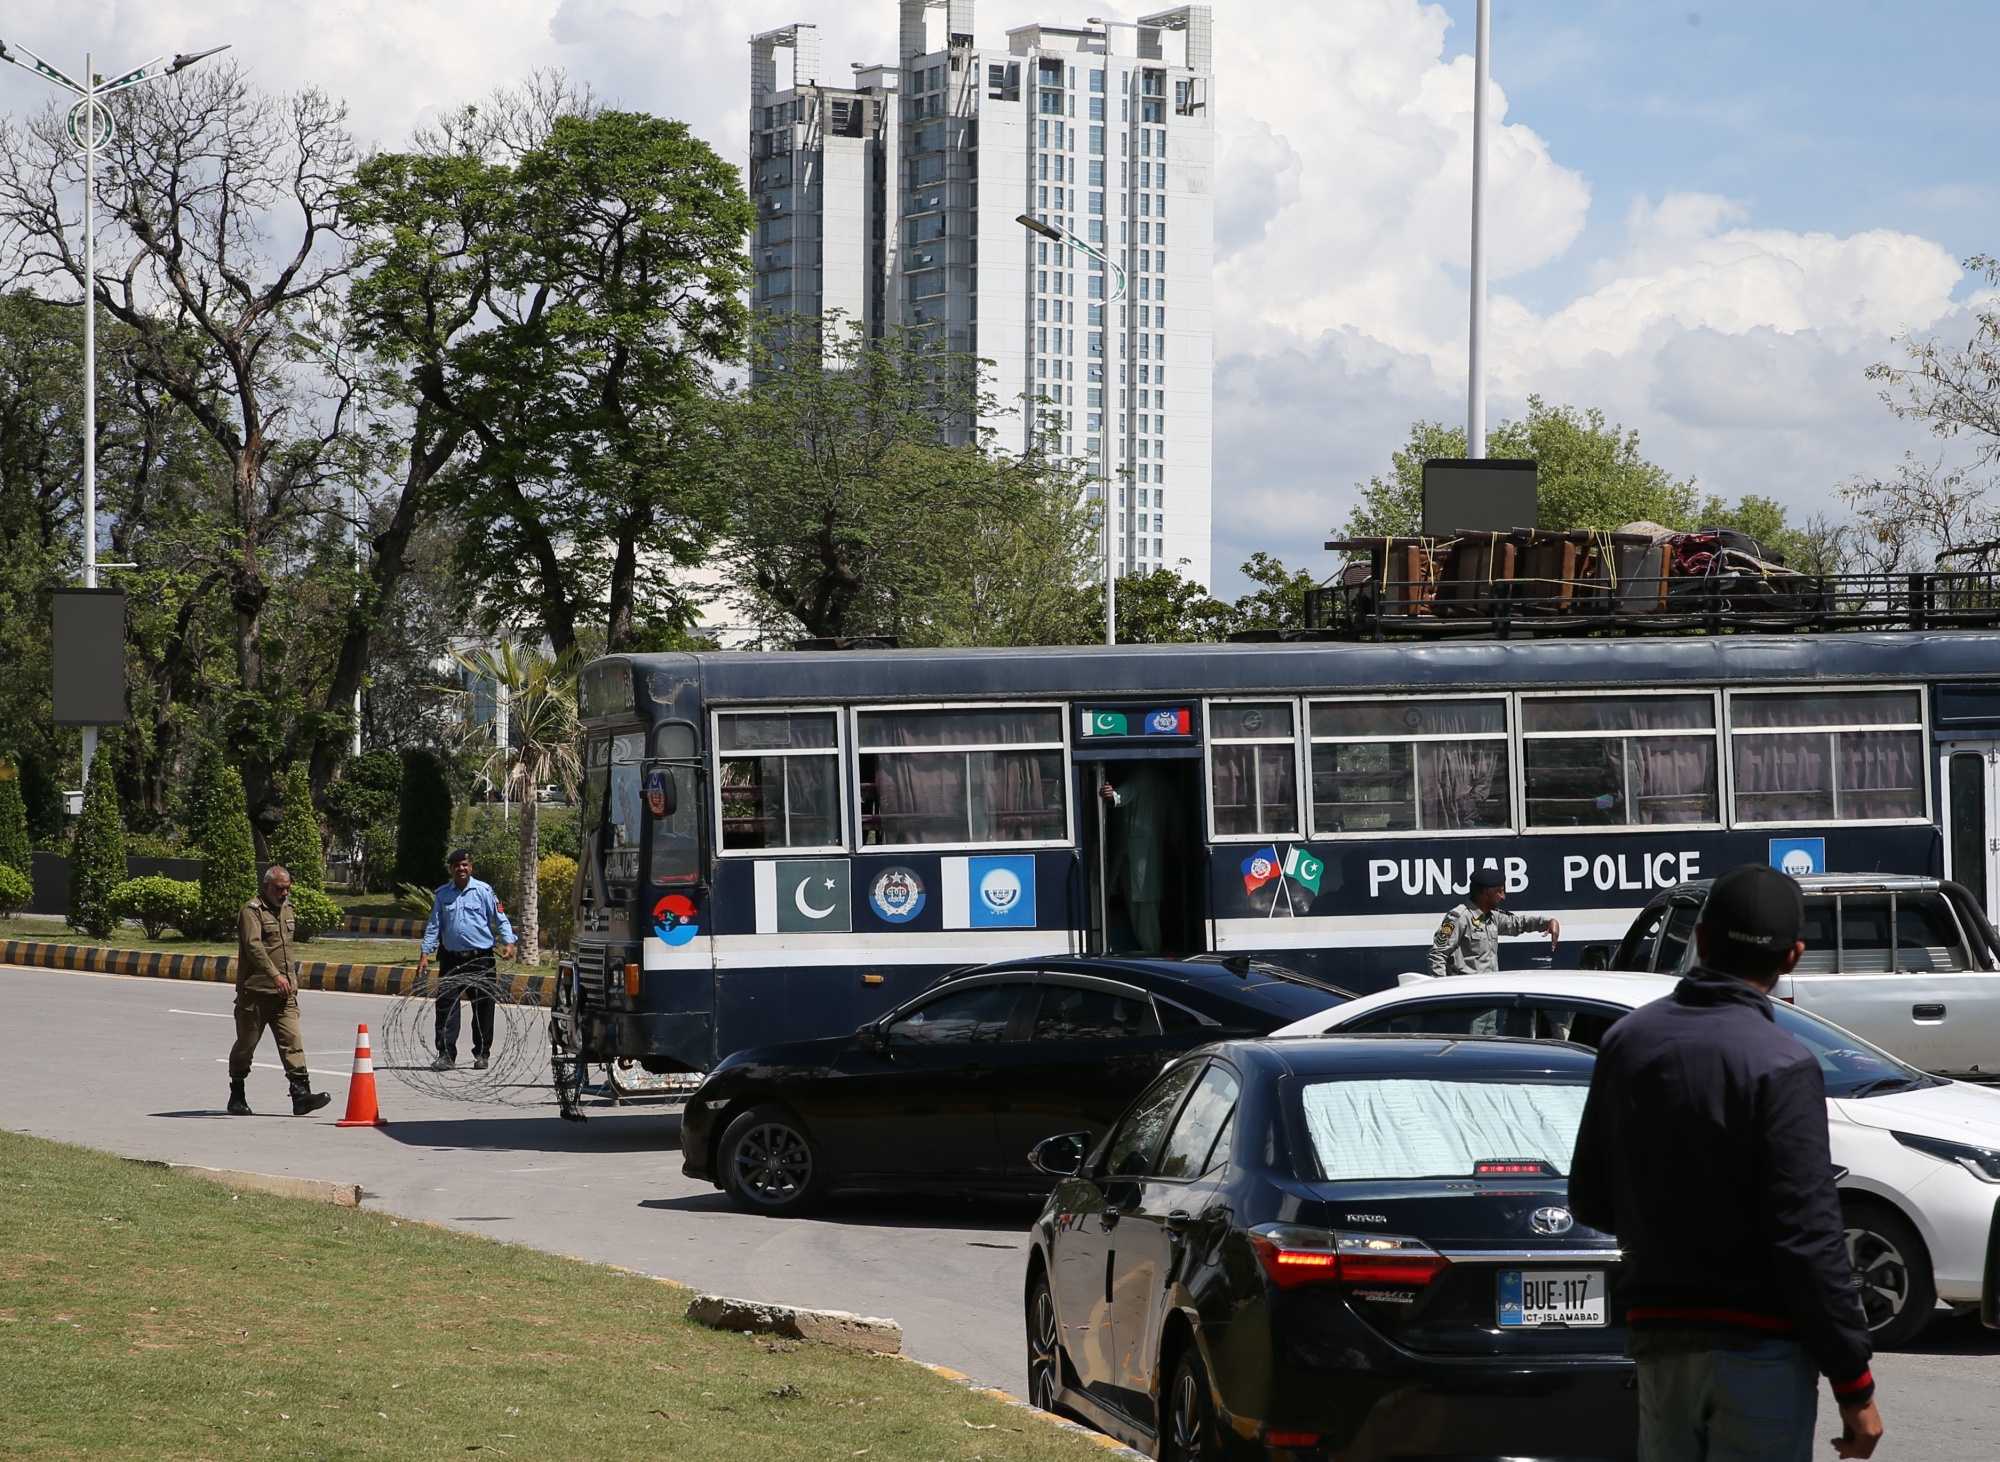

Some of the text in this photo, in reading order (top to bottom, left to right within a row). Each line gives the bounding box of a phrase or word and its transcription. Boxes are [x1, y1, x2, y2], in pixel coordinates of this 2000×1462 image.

[1563, 851, 1700, 893] POLICE
[1345, 1213, 1387, 1223] TOYOTA
[1523, 1313, 1599, 1322] ICT-ISLAMABAD
